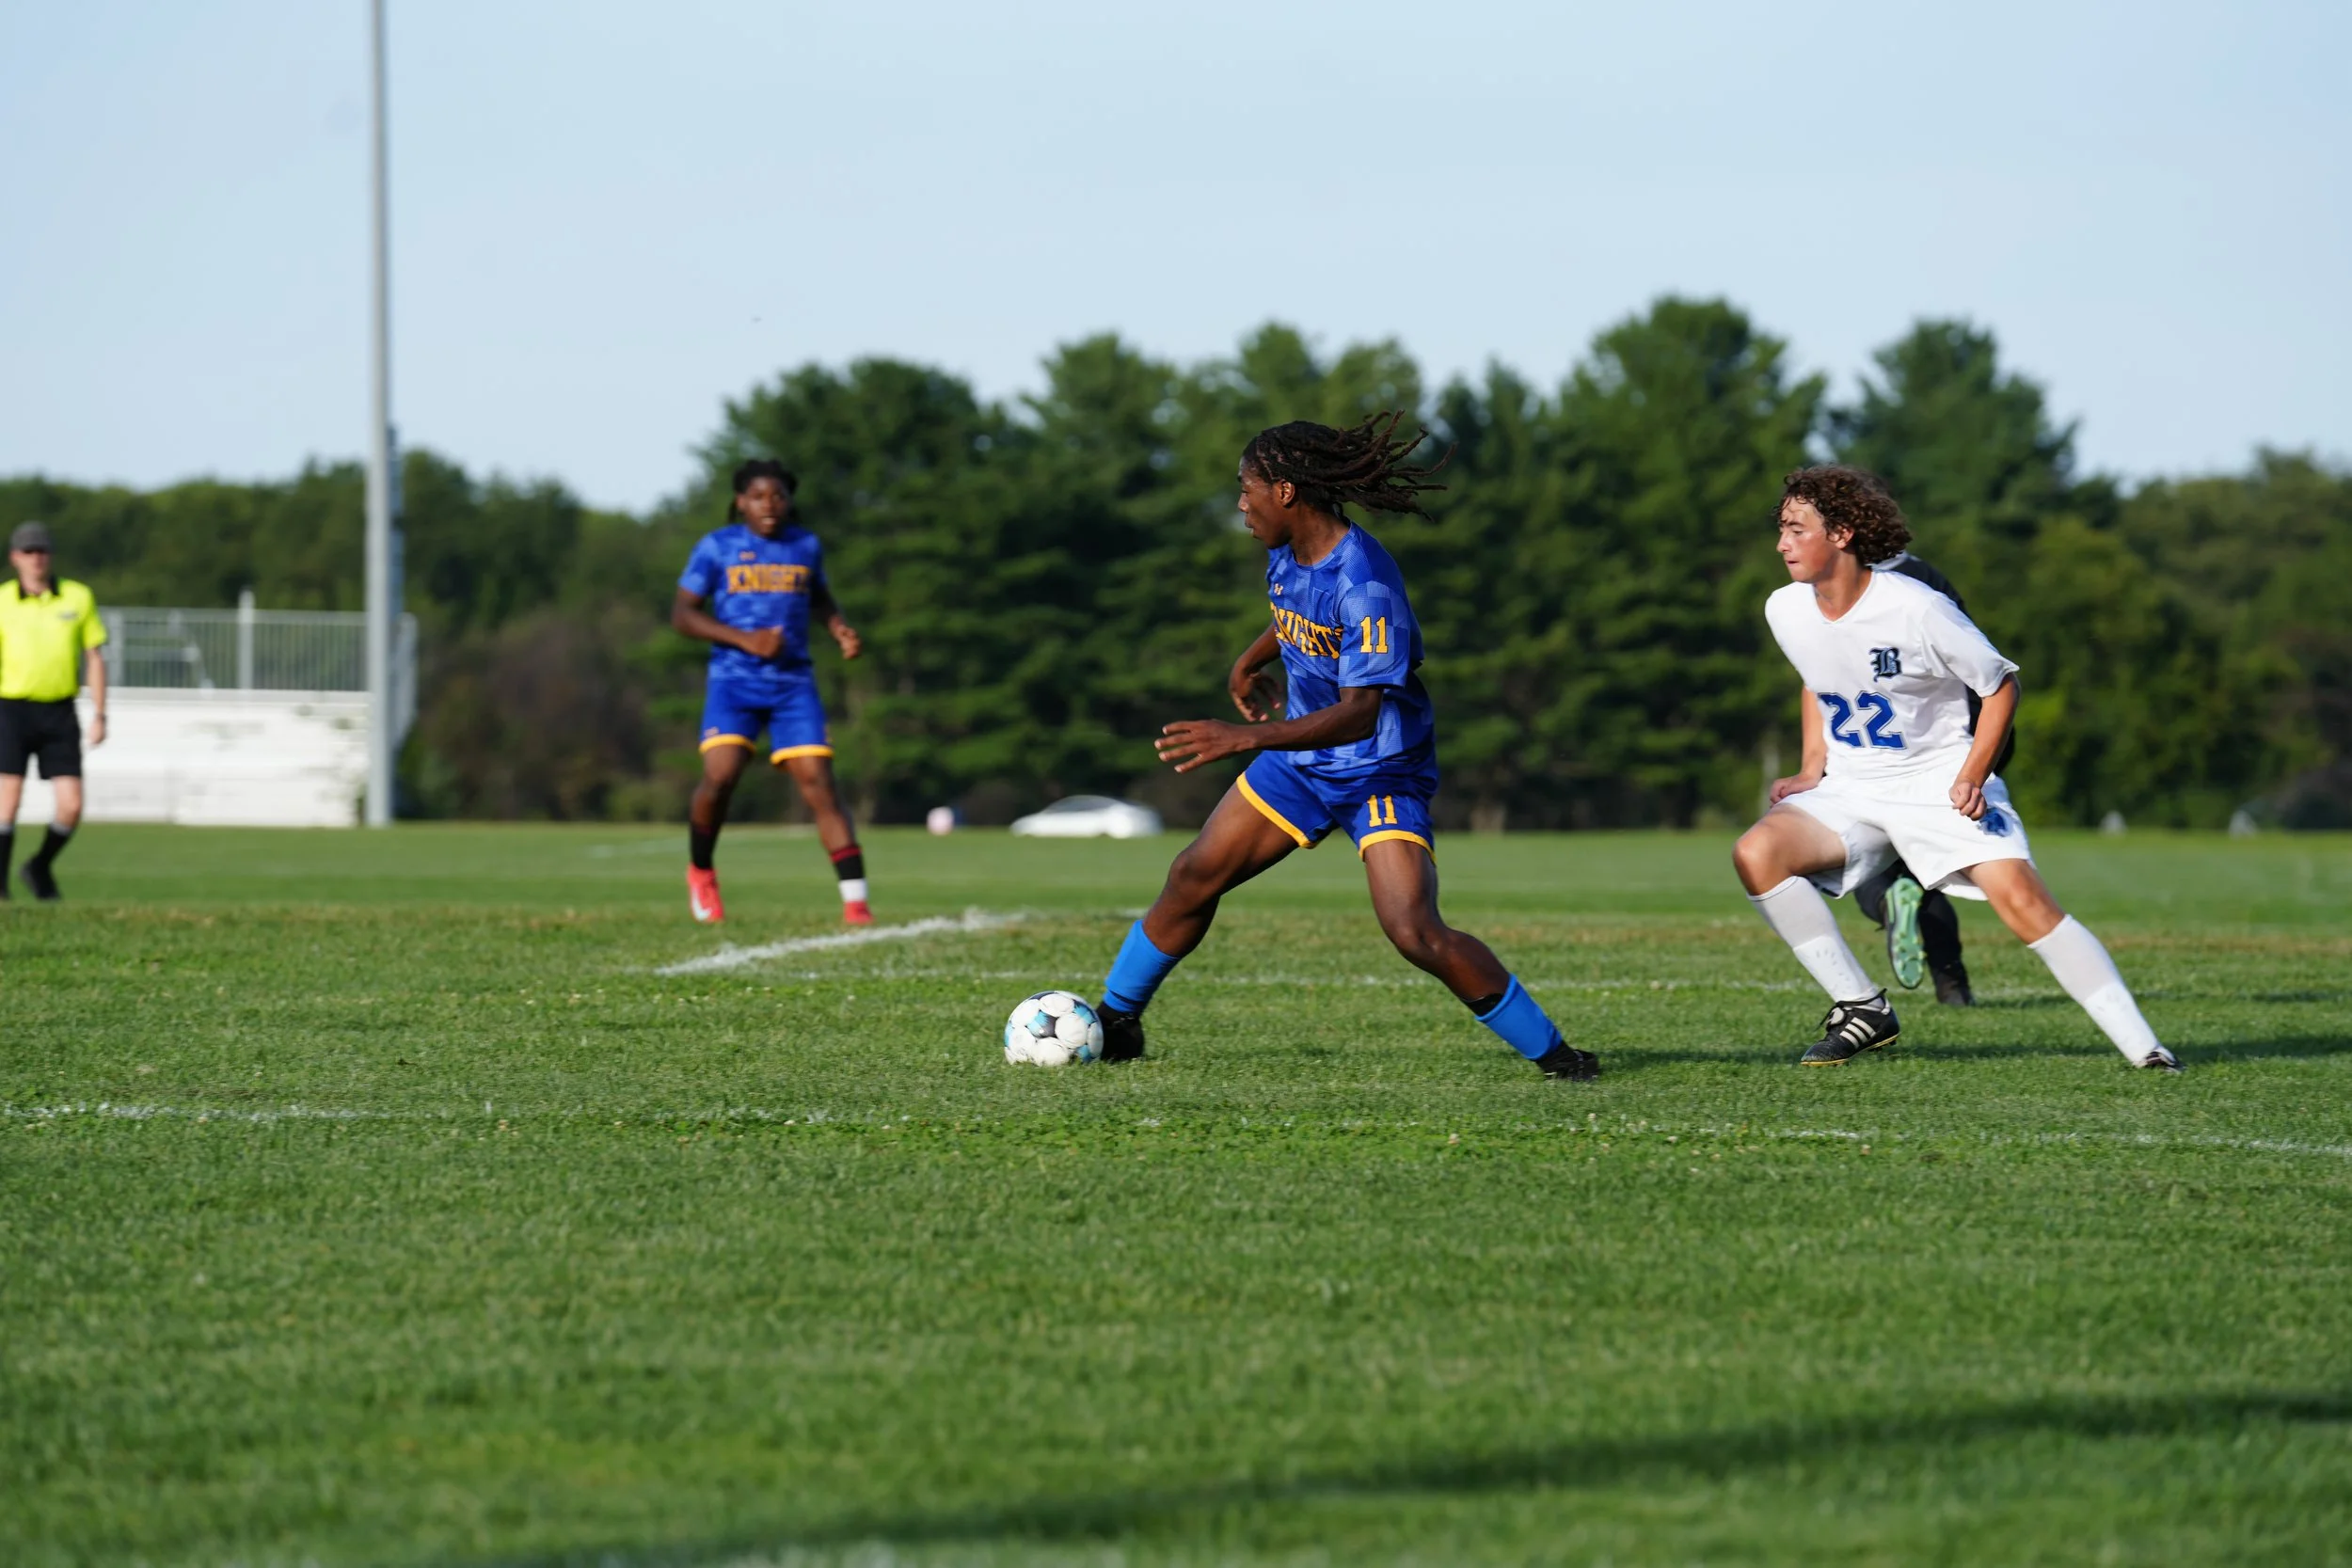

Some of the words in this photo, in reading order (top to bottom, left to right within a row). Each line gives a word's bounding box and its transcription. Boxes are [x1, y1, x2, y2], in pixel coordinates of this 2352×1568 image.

[1360, 616, 1389, 654] 11
[1869, 646, 1902, 682] B
[1818, 690, 1908, 749] 22
[1368, 794, 1398, 828] 11
